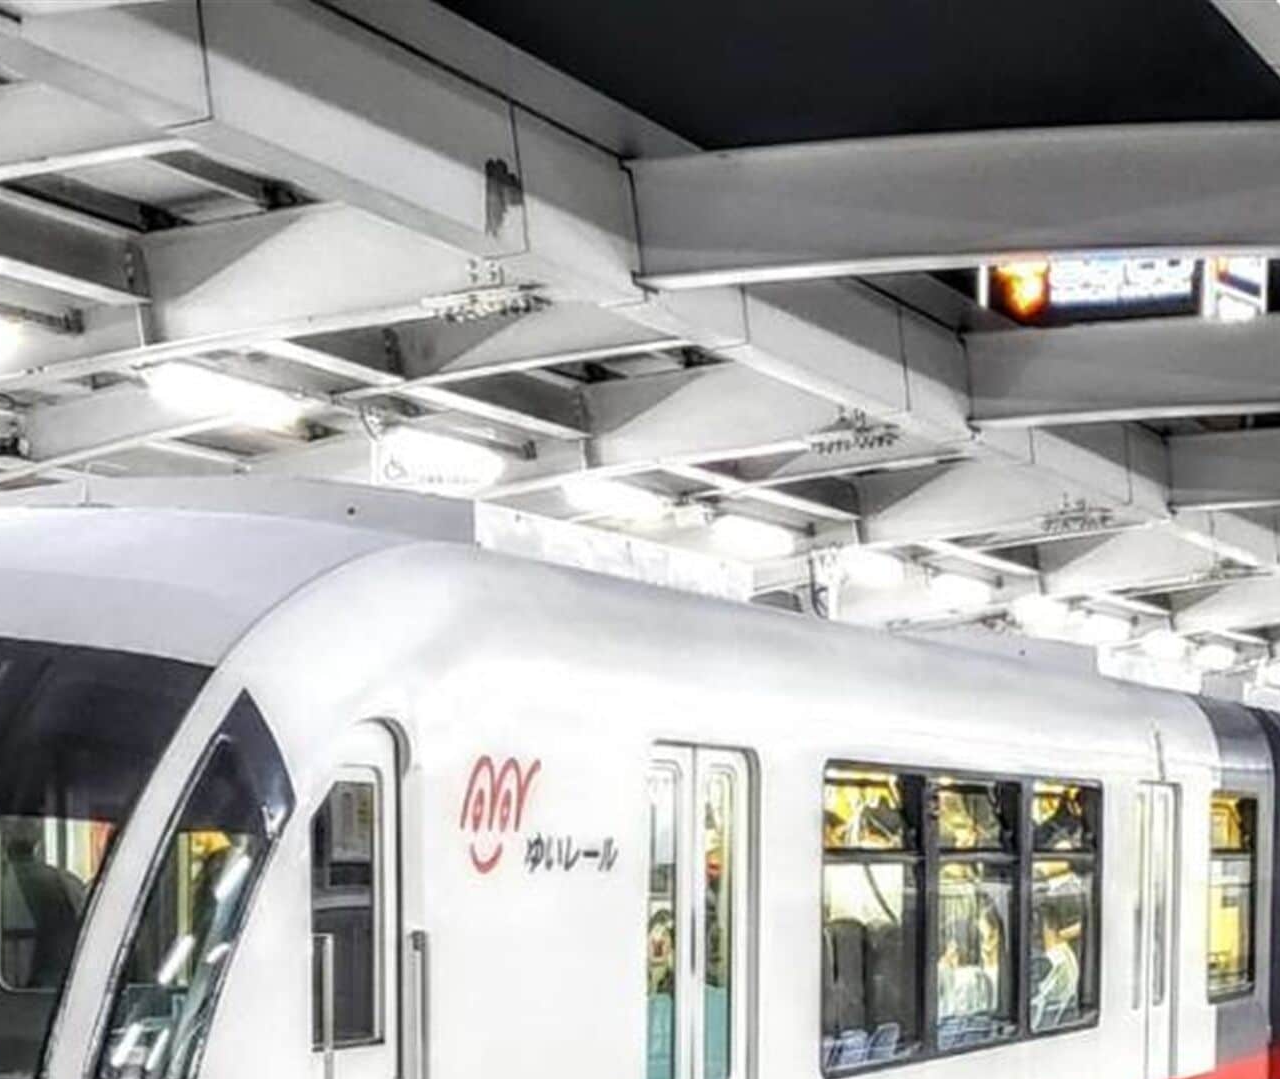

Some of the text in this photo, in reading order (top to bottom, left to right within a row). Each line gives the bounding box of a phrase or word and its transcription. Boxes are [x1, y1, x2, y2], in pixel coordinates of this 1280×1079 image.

[524, 832, 619, 873] ゆいレール
